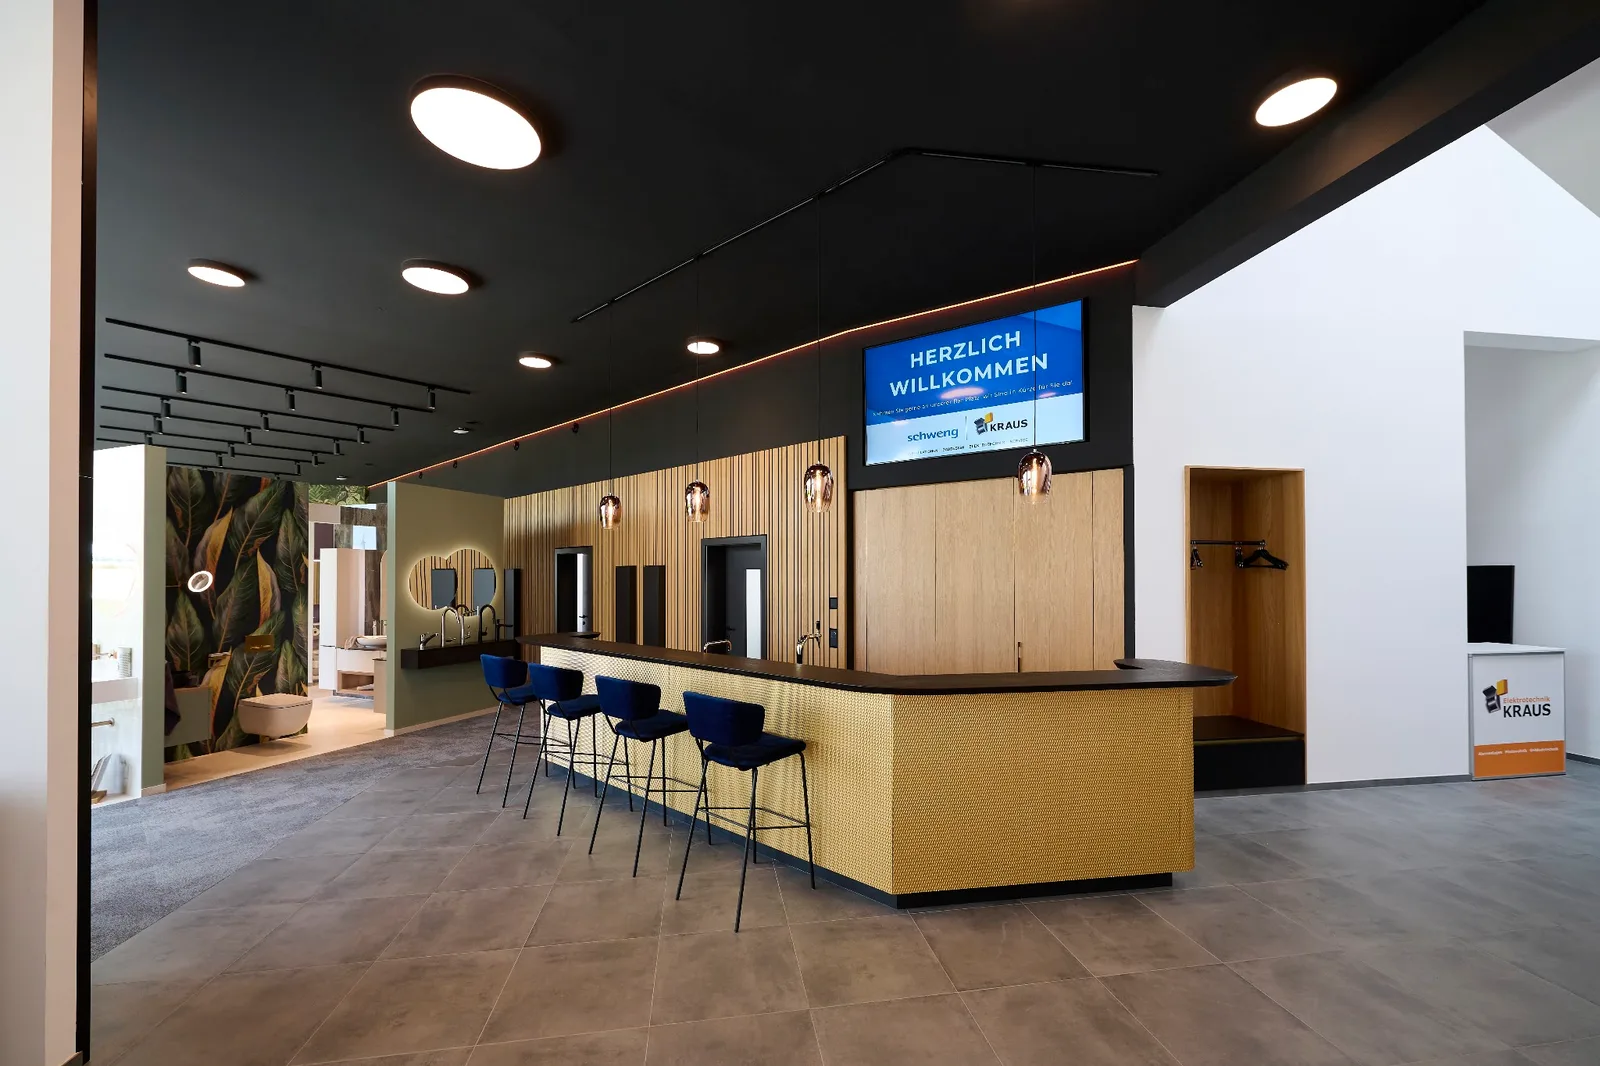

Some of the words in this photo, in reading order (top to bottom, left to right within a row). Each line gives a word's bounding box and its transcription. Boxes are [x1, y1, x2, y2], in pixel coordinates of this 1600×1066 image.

[910, 330, 1021, 369] HERZLICH
[889, 353, 1048, 397] WILLKOMMEN
[990, 419, 1028, 432] KRAUS
[907, 428, 959, 442] schweng
[1503, 696, 1551, 704] Elektrotechnik
[1503, 703, 1551, 718] KRAUS
